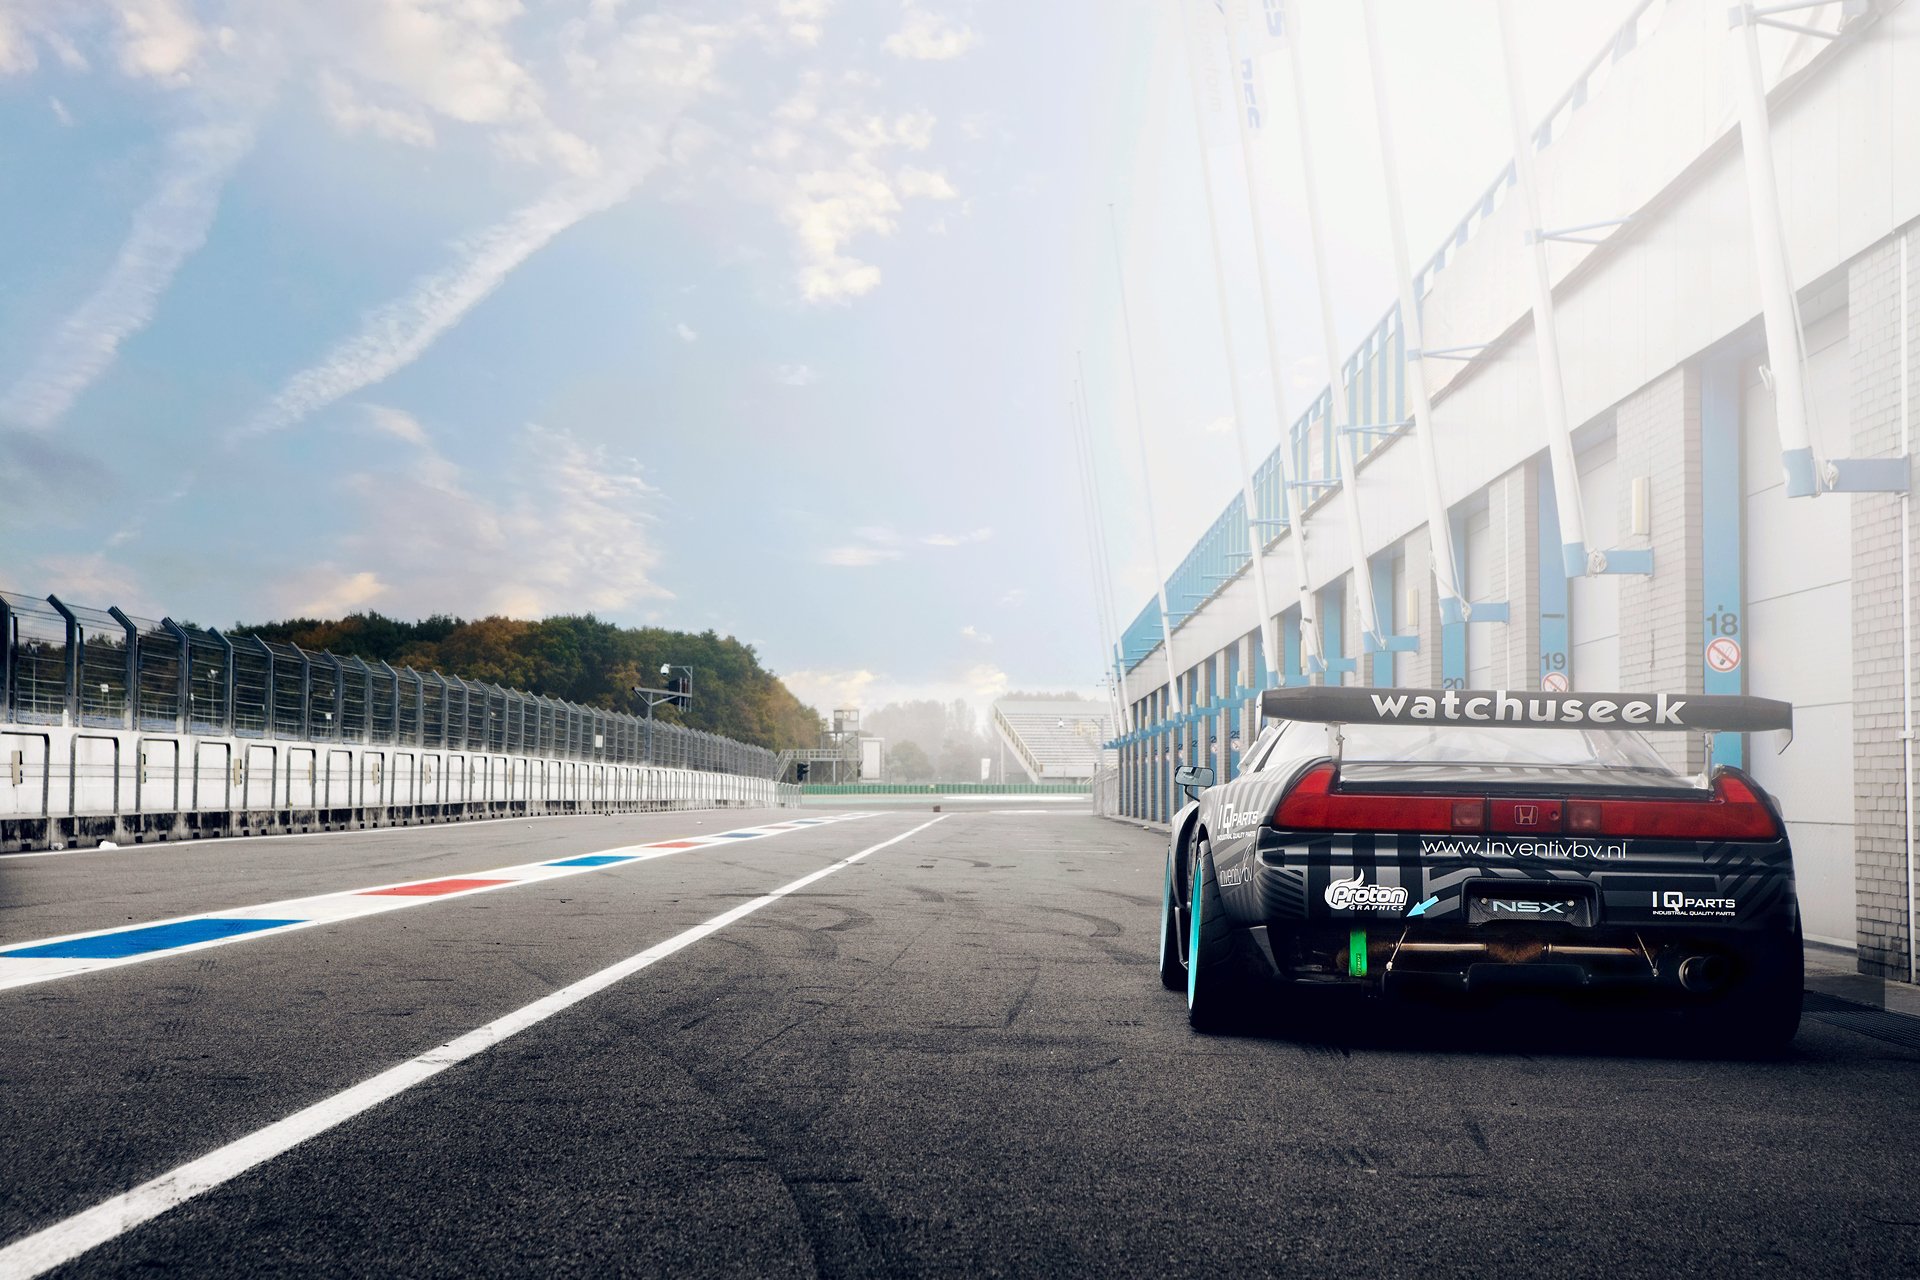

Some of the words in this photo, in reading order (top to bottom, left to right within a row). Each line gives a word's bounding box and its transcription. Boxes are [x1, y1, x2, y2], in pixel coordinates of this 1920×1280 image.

[1706, 612, 1738, 636] 18
[1541, 652, 1566, 670] 19
[1370, 690, 1687, 725] watchuseek
[1232, 810, 1259, 828] PARTS
[1421, 838, 1627, 859] www.inventivbv.nl
[1492, 900, 1565, 914] NSX
[1684, 898, 1736, 908] PARTS
